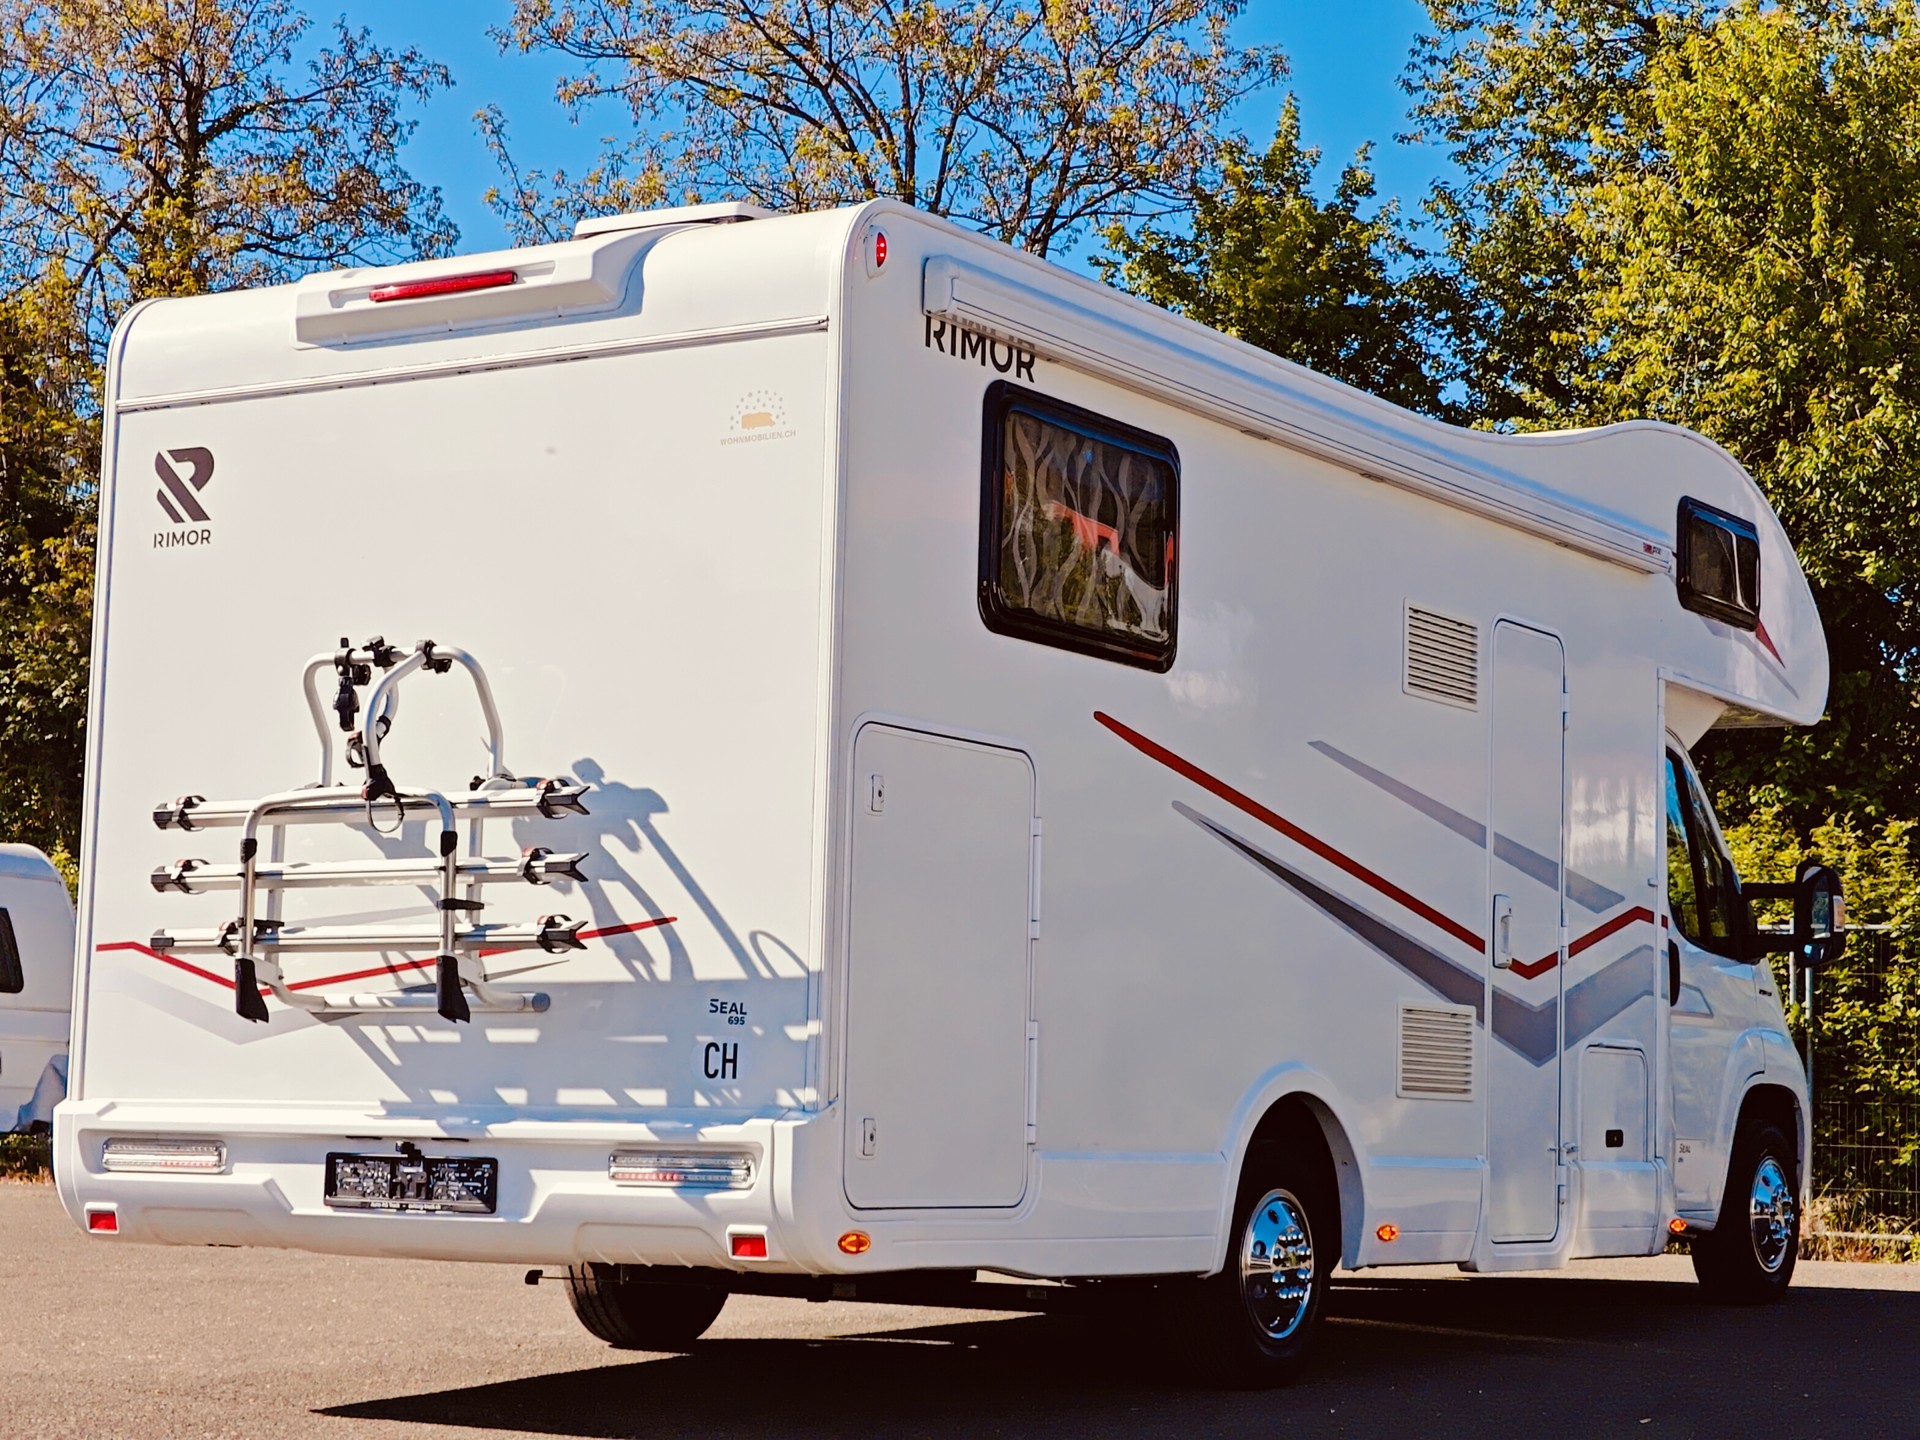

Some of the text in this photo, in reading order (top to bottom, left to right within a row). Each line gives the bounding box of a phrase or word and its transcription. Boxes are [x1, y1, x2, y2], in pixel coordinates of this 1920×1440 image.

[925, 315, 1035, 383] RIMOR
[720, 430, 796, 446] WOHNMOBILIEN.CH
[153, 529, 211, 549] RIMOR
[709, 999, 747, 1016] SEAL
[728, 1016, 745, 1026] 695
[704, 1042, 738, 1080] CH
